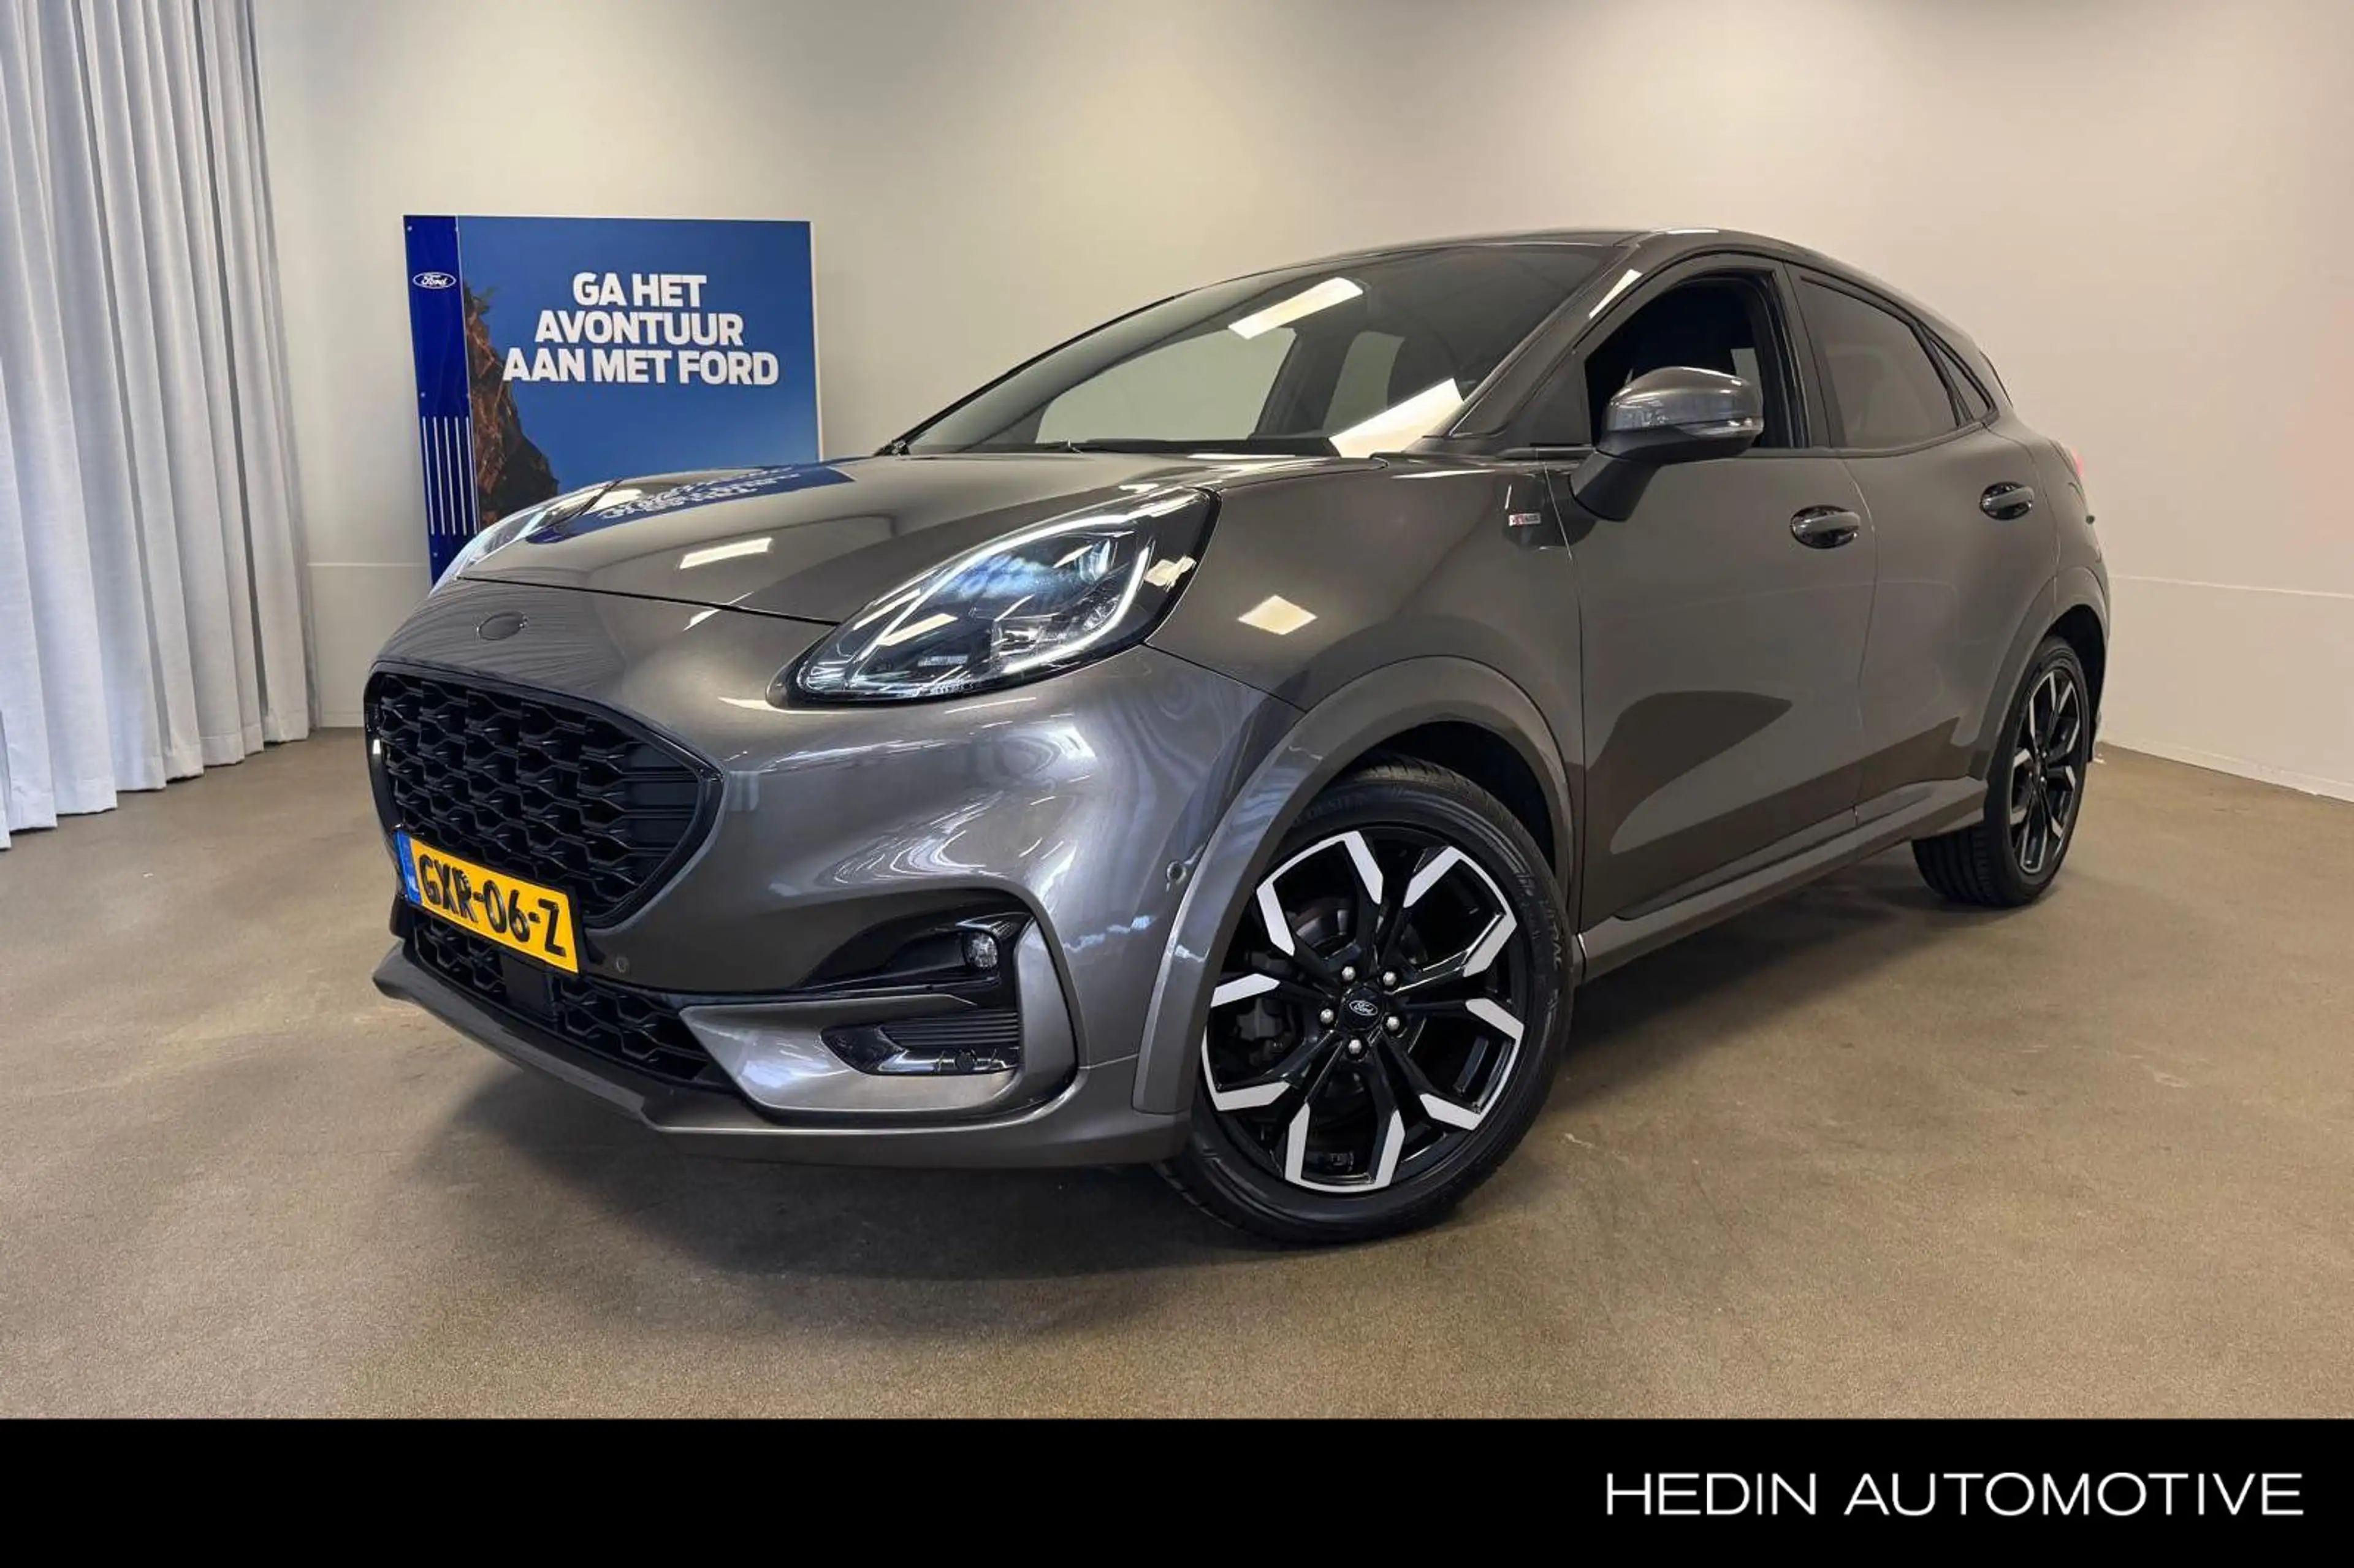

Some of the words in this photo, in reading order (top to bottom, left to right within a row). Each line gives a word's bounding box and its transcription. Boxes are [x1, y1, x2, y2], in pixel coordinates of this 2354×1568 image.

[573, 272, 628, 306] GA
[633, 274, 707, 308] HET
[535, 310, 744, 346] AVONTUUR
[502, 348, 586, 382] AAN
[592, 349, 672, 383] MET
[678, 351, 779, 385] FORD
[419, 854, 567, 958] GXR-06-Z
